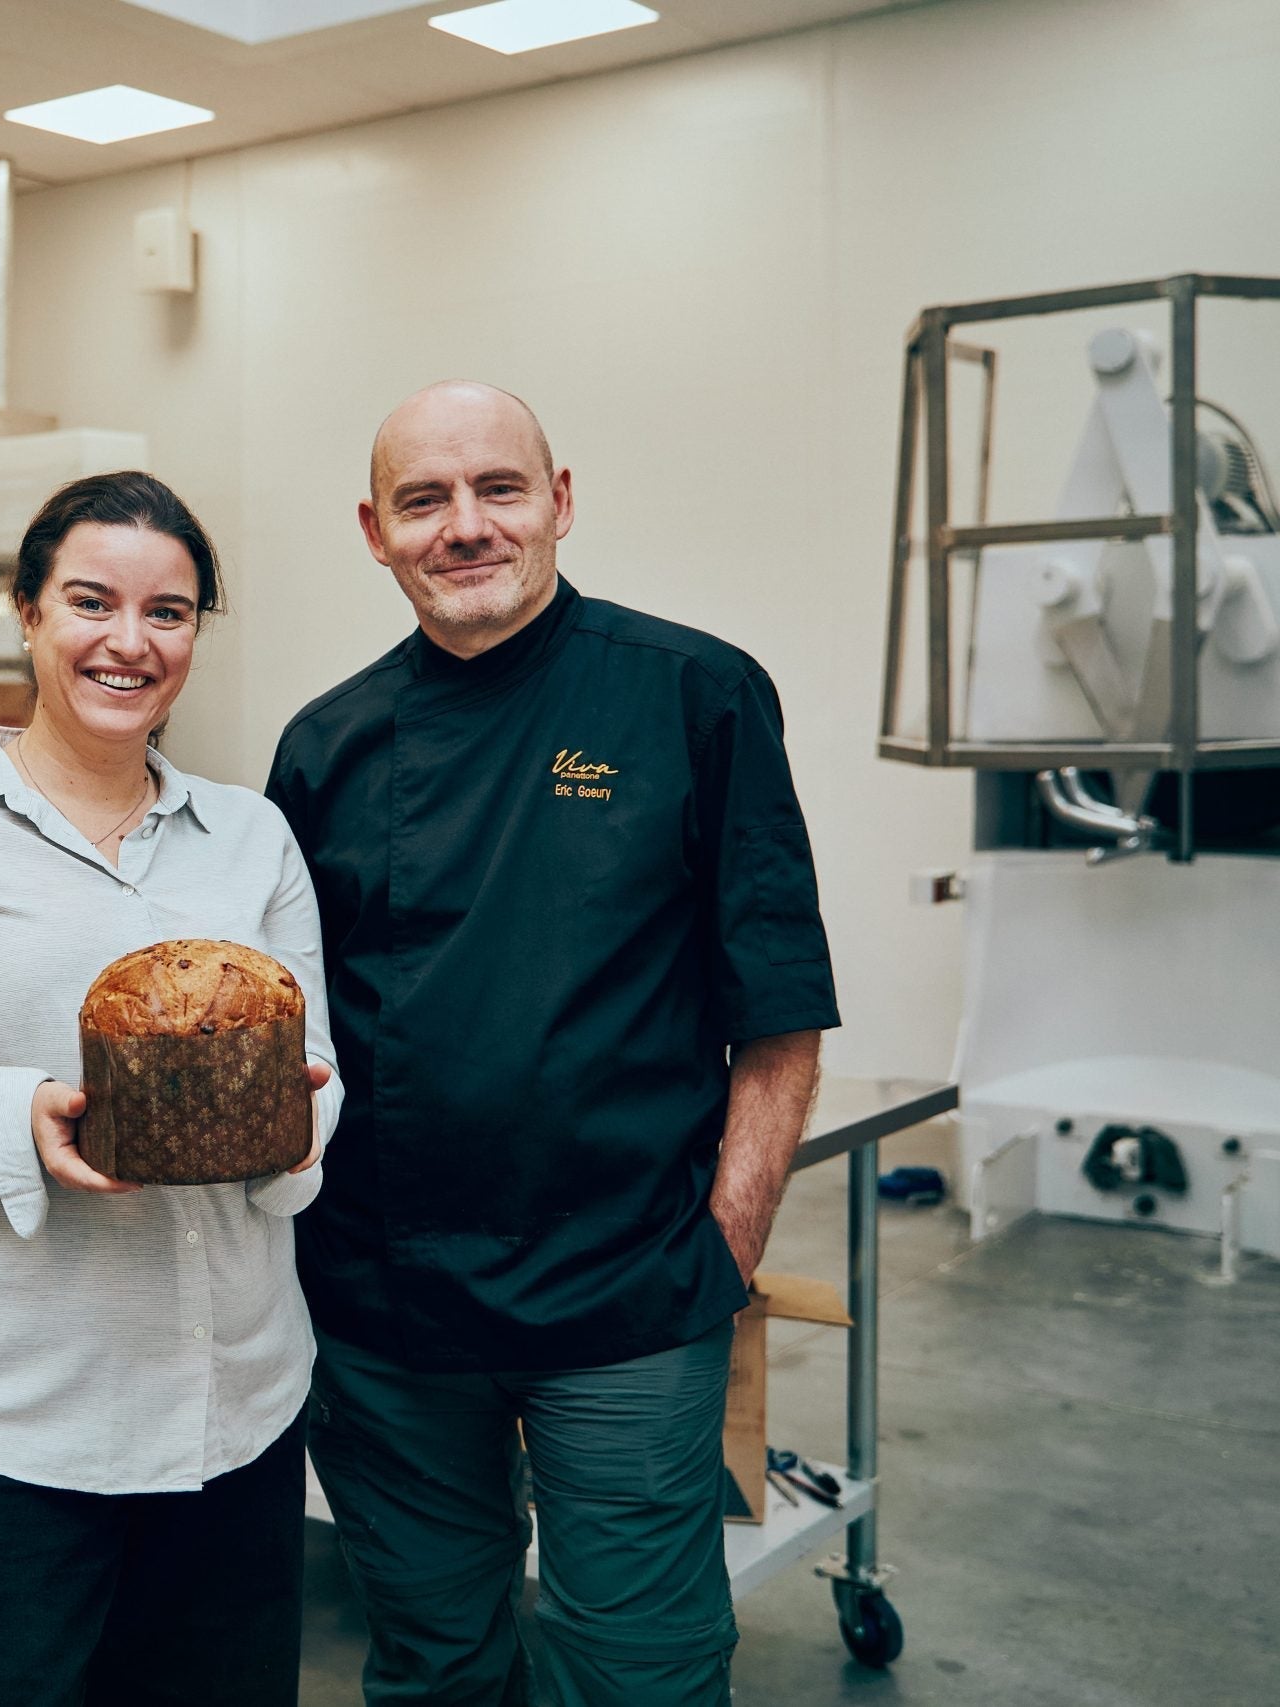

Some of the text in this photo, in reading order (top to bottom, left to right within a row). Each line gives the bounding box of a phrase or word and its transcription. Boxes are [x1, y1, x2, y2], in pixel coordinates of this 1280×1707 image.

[552, 748, 619, 774] Viva
[555, 784, 612, 801] Eric Goeury
